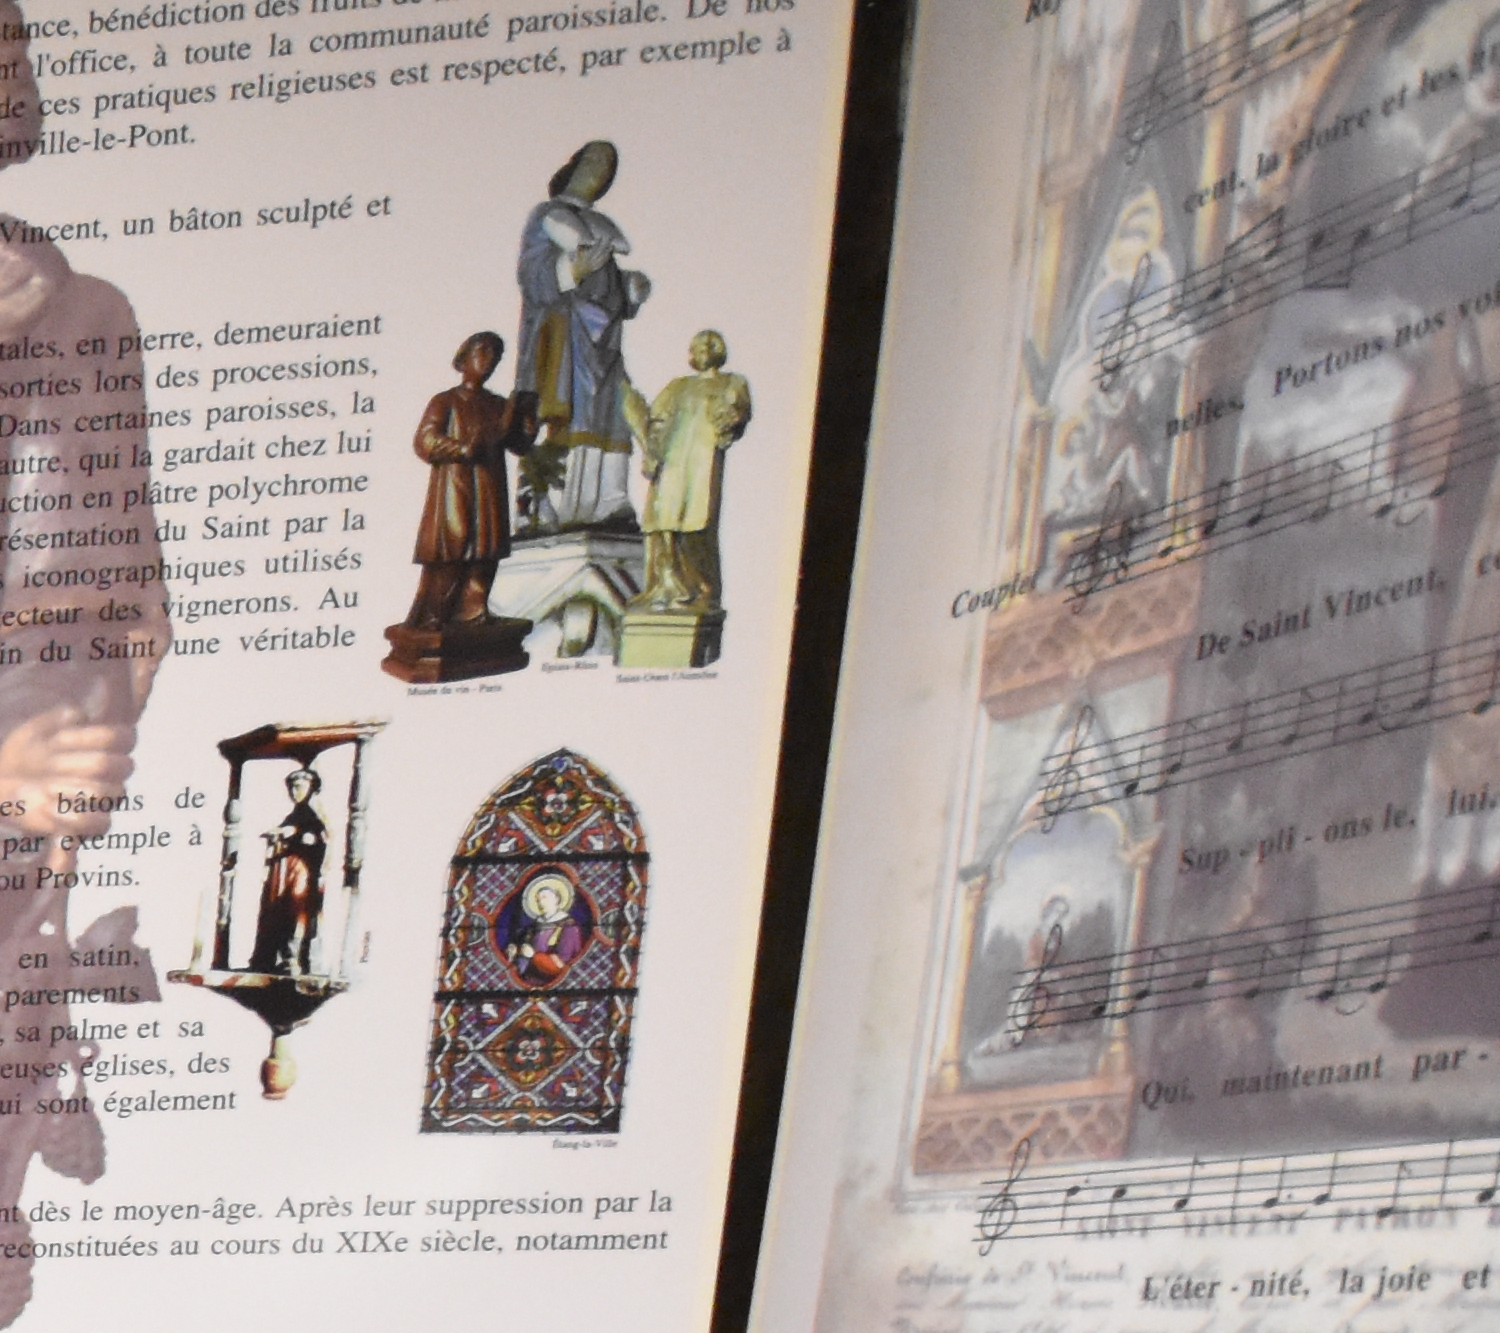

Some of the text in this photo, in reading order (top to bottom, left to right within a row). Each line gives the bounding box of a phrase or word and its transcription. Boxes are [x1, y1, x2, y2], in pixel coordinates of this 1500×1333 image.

[122, 216, 154, 236] un
[168, 206, 242, 232] bâton
[256, 194, 352, 229] sculpté
[365, 195, 390, 217] et
[1195, 569, 1445, 661] De Saint Vincent,
[35, 864, 139, 889] Provins.
[169, 1239, 199, 1256] au
[209, 1238, 280, 1255] cours
[291, 1231, 323, 1254] du
[335, 1230, 409, 1254] XIXe
[420, 1228, 503, 1252] siècle,
[515, 1231, 668, 1251] notamment
[1248, 1267, 1310, 1297] nité,
[1338, 1267, 1364, 1294] la
[1372, 1264, 1431, 1300] joie
[1462, 1263, 1491, 1290] et
